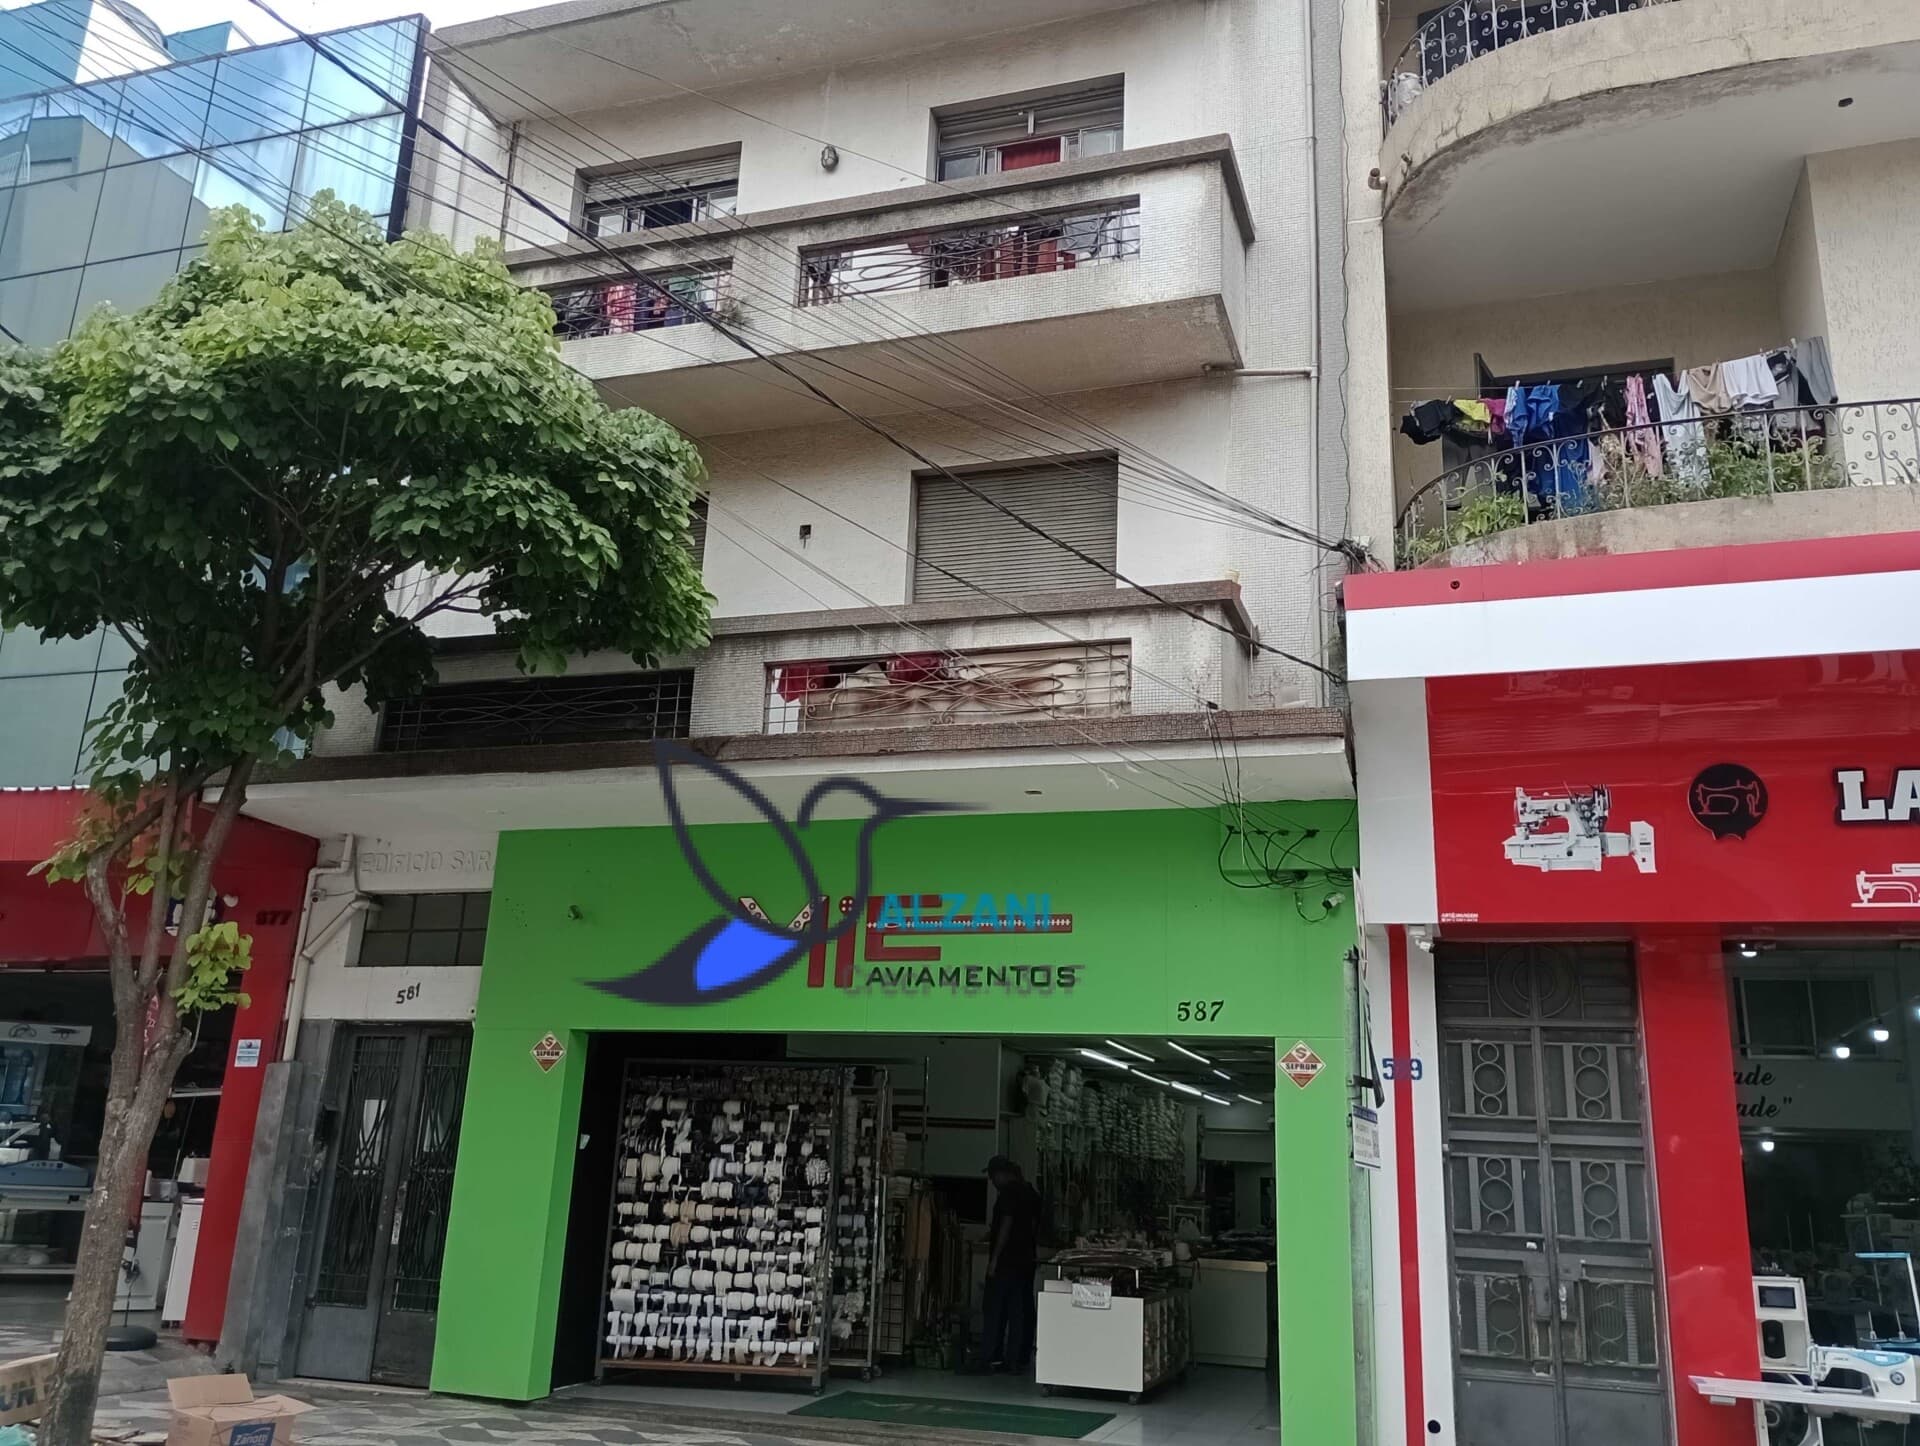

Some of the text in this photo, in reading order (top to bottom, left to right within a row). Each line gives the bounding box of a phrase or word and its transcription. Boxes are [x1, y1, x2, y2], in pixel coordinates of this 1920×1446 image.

[866, 966, 1076, 987] AVIAMENTOS
[396, 982, 421, 1004] 581
[1177, 999, 1224, 1022] 587
